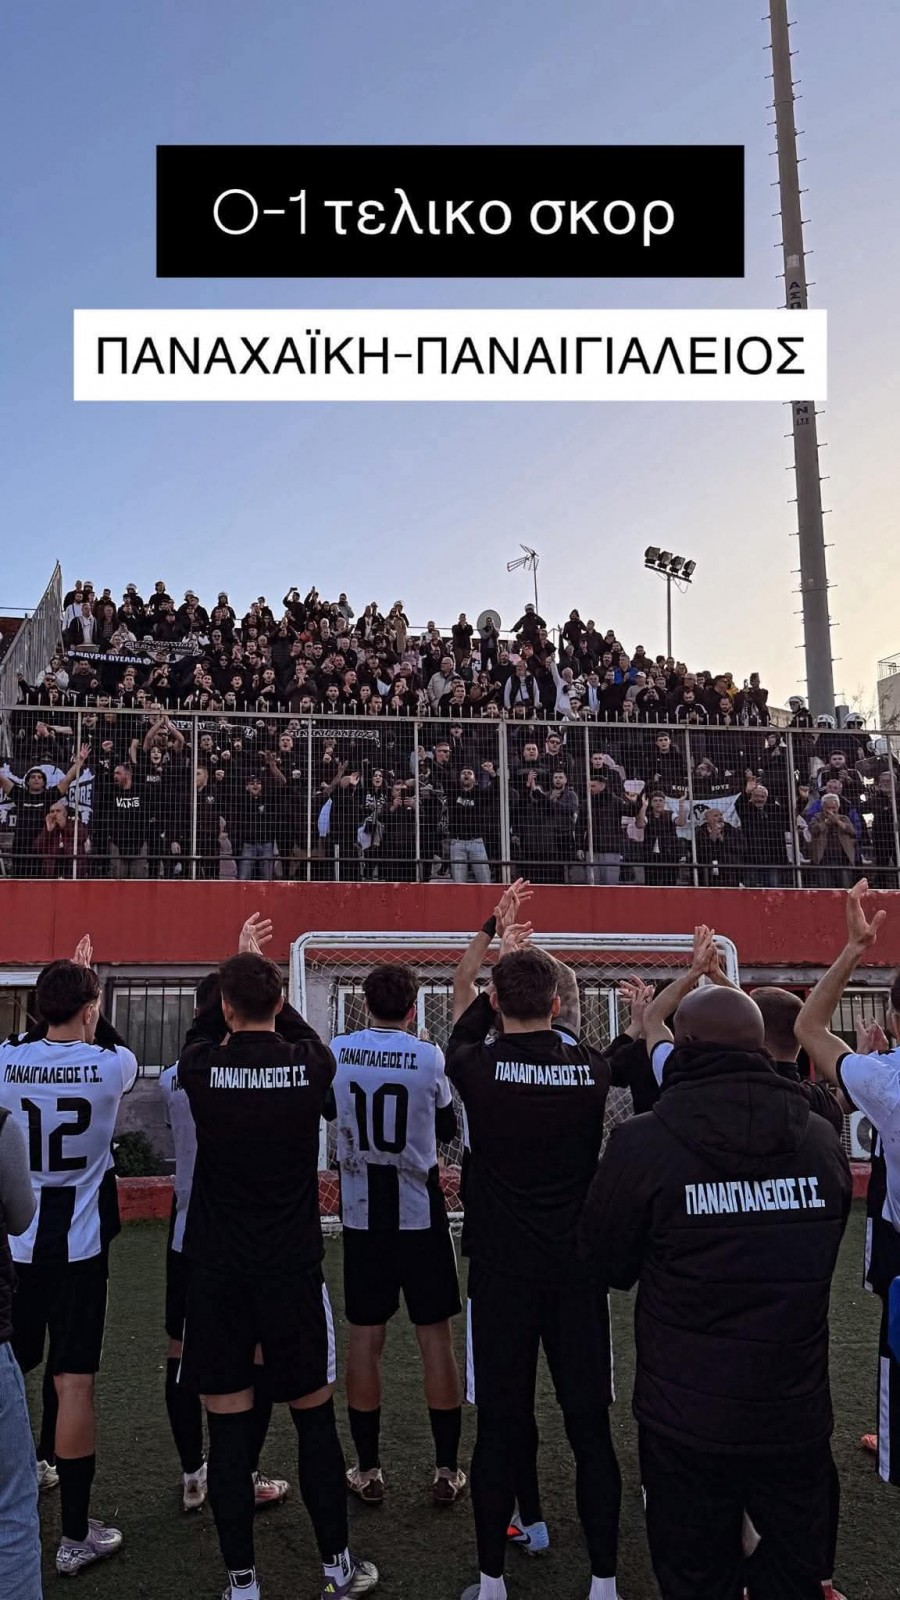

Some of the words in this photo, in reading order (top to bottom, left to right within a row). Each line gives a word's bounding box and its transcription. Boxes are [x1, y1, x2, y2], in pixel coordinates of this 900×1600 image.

[75, 651, 107, 661] ΜΑΥΡΗ
[116, 797, 140, 808] VANS
[339, 1047, 402, 1069] ΠΑΝΑΙΓΙΑΛΕΙΟΣ
[4, 1064, 81, 1084] ΠΑΝΑΙΓΙΑΛΕΙΟΣ
[210, 1066, 291, 1089] ΠΑΝΑΙΓΙΑΛΕΙΟΣ
[495, 1061, 578, 1086] ΠΑΝΑΙΓΙΑΛΕΙΟΣ
[349, 1080, 409, 1155] 10
[20, 1097, 92, 1173] 12
[685, 1178, 800, 1215] ΠΑΝΑΙΓΙΑΛΕΙΟΣ
